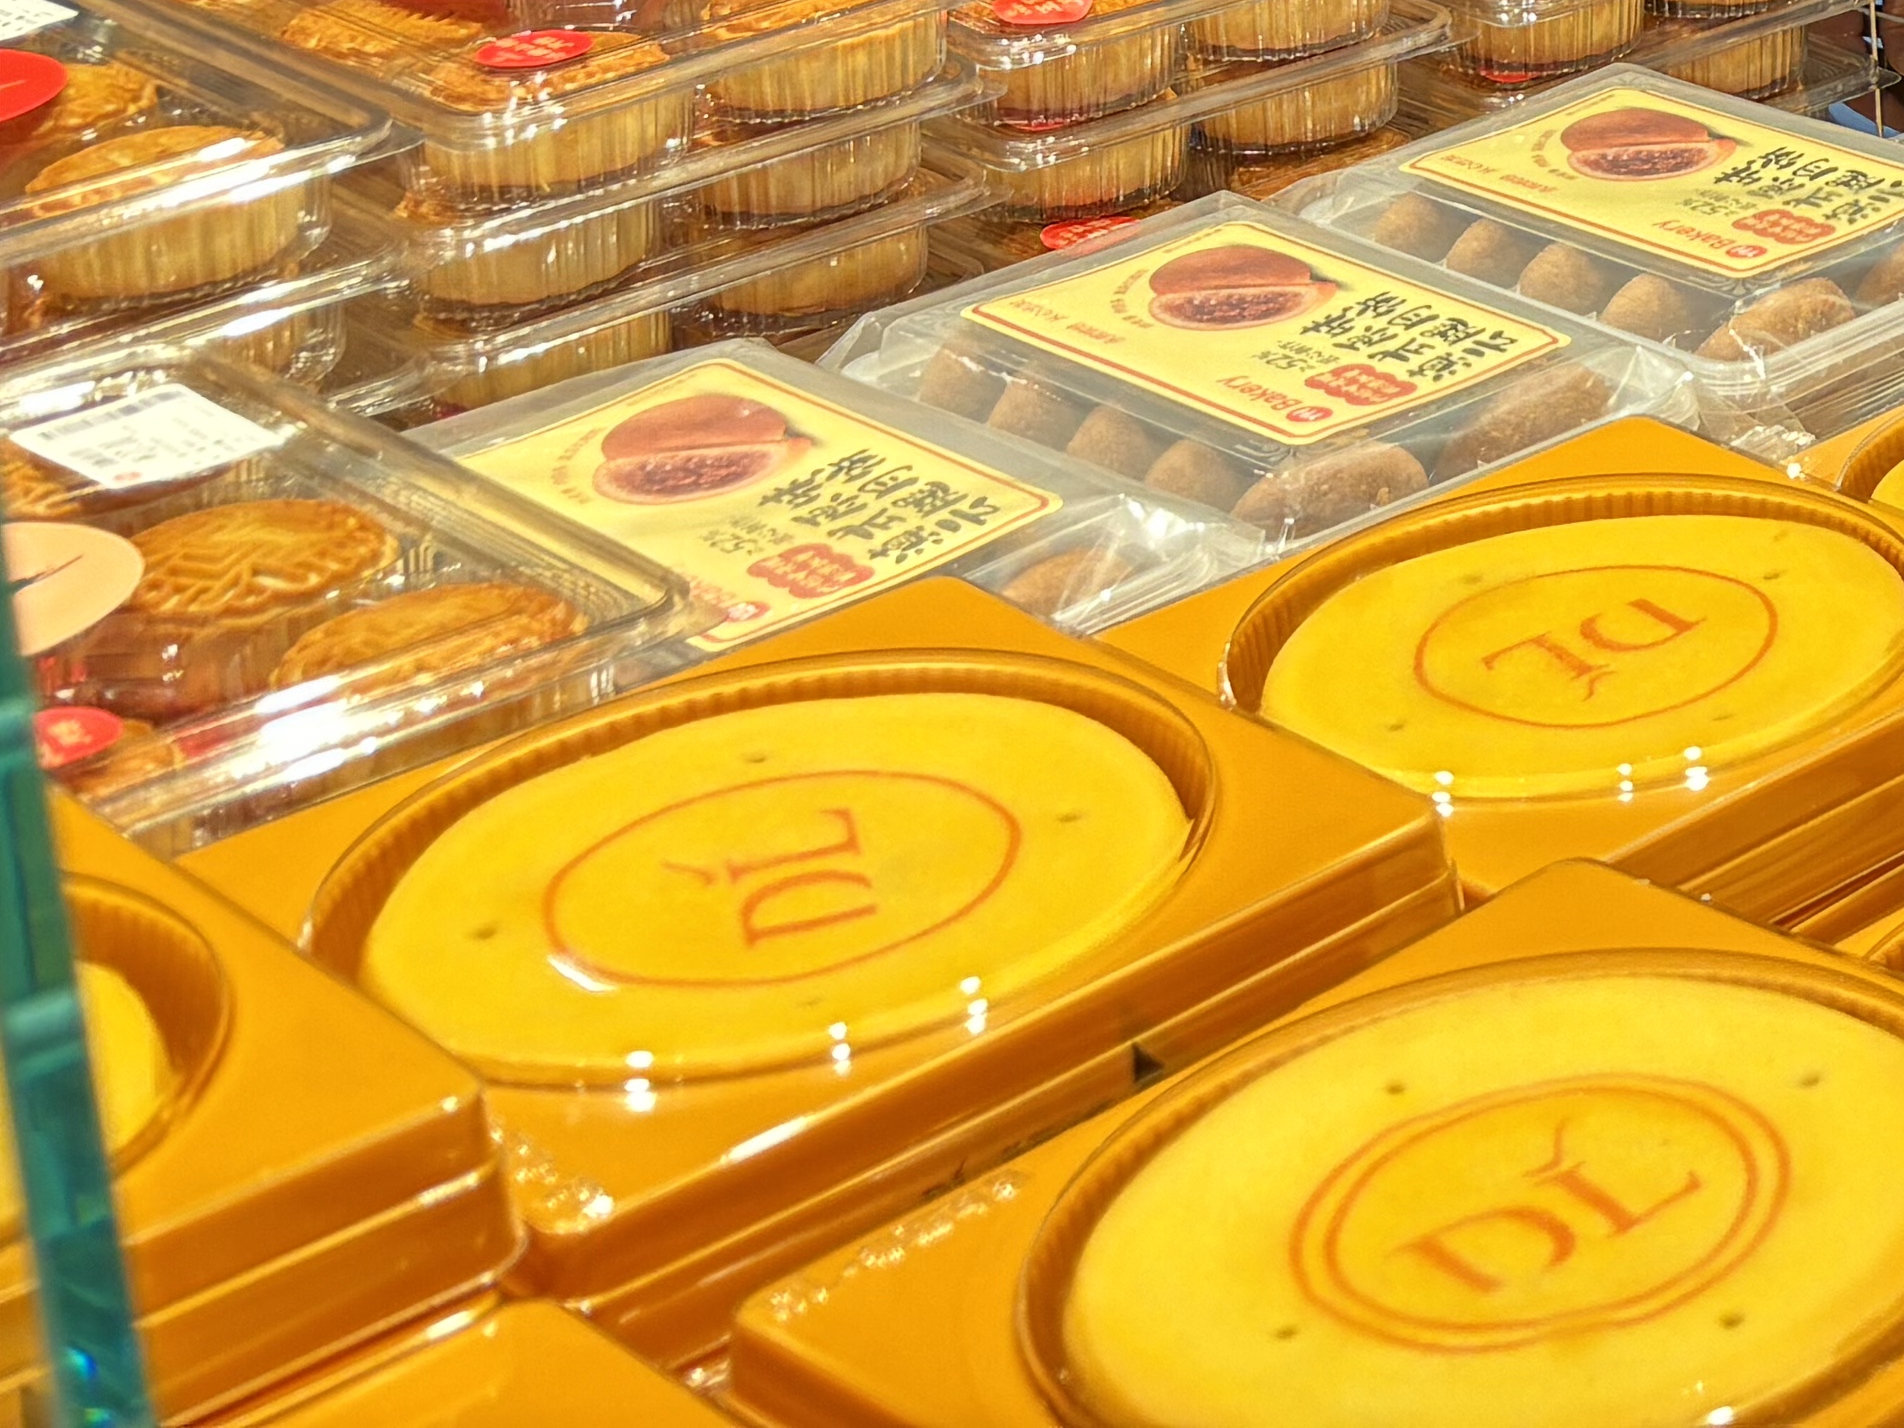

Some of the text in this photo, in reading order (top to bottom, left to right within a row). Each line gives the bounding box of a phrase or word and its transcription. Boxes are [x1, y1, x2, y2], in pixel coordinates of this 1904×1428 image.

[1654, 221, 1734, 248] Bakery
[1219, 376, 1300, 409] Bakery
[1482, 597, 1708, 702] DL
[662, 807, 881, 949] DL
[1396, 1118, 1702, 1294] DL
